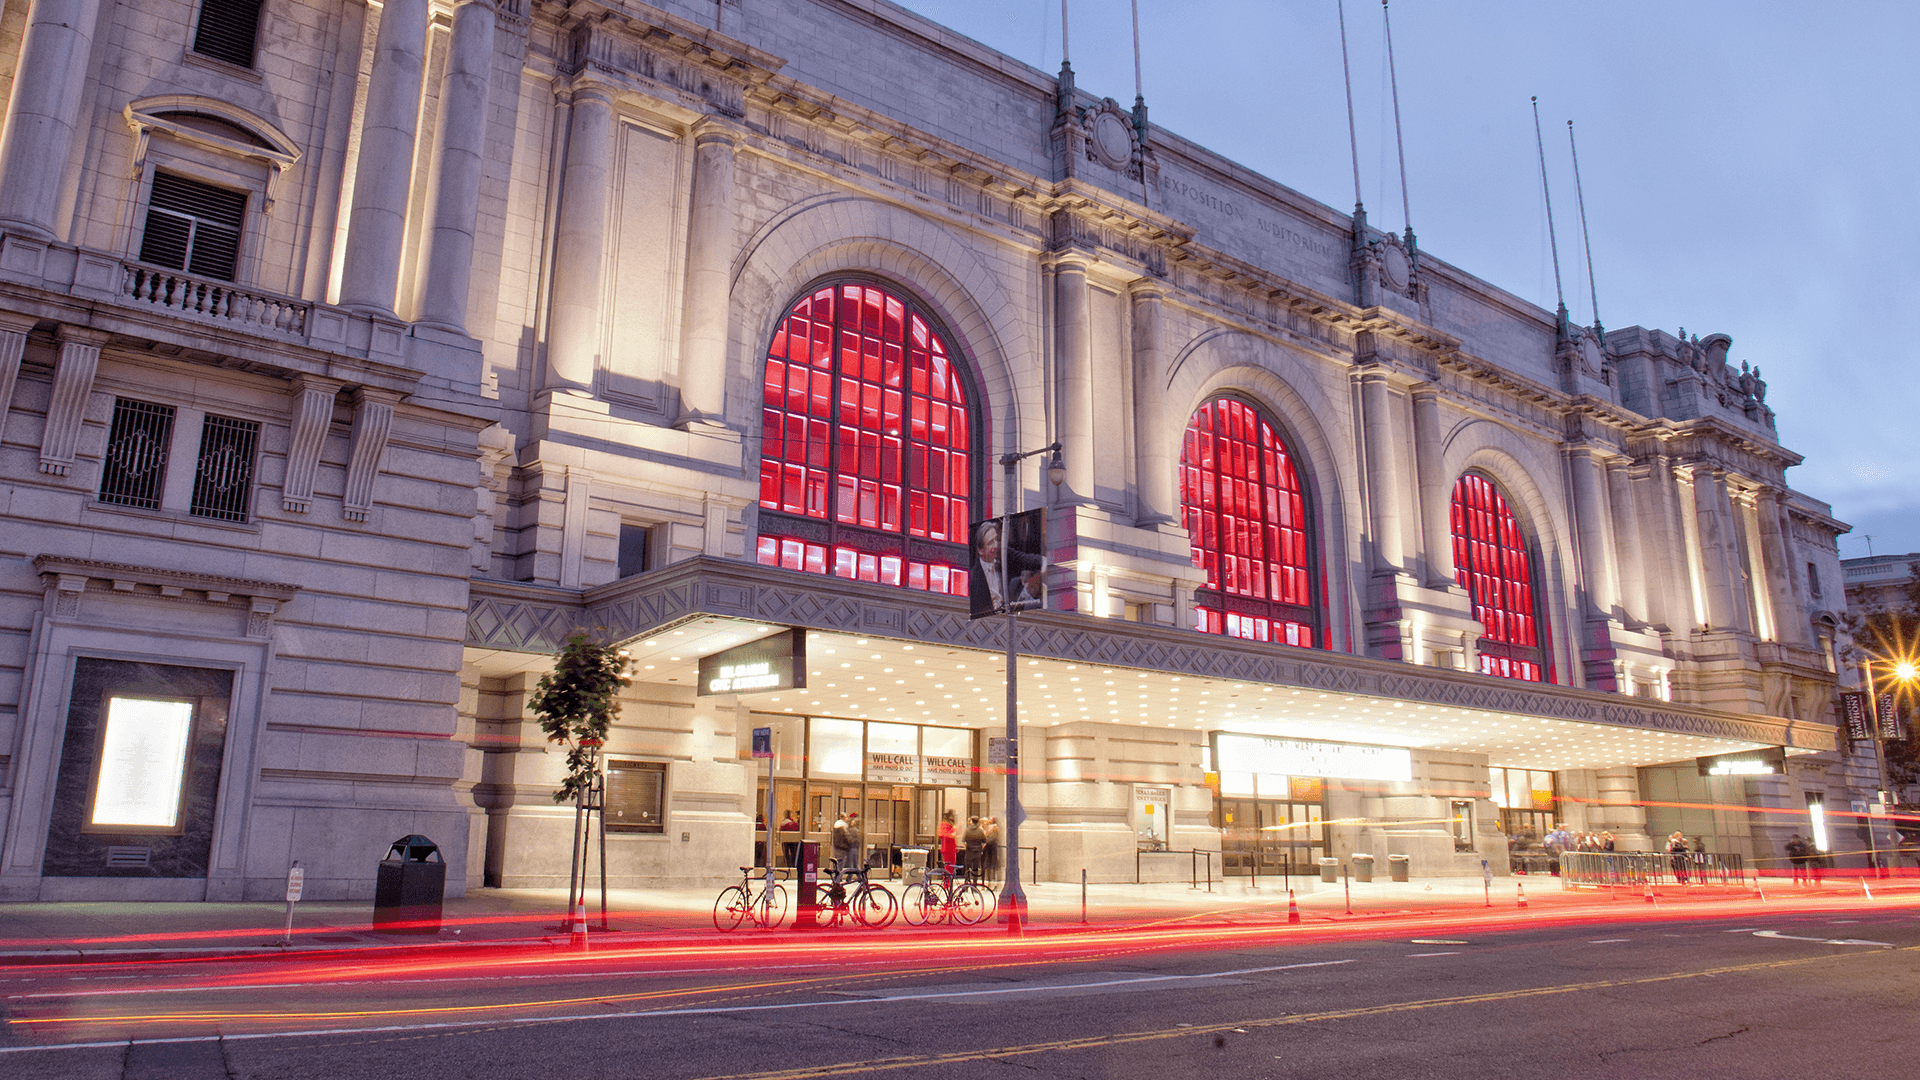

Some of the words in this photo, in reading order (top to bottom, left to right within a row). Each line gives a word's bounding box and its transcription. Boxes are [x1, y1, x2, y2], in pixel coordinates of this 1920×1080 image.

[1164, 175, 1244, 221] EXPOSITION
[1257, 218, 1329, 255] AUDITORIUM
[1850, 694, 1864, 739] SYMPHONY
[1884, 693, 1896, 738] SYMPHONY
[872, 754, 892, 764] WILL
[893, 755, 914, 765] CALL
[927, 757, 945, 767] WILL
[947, 758, 966, 768] CALL
